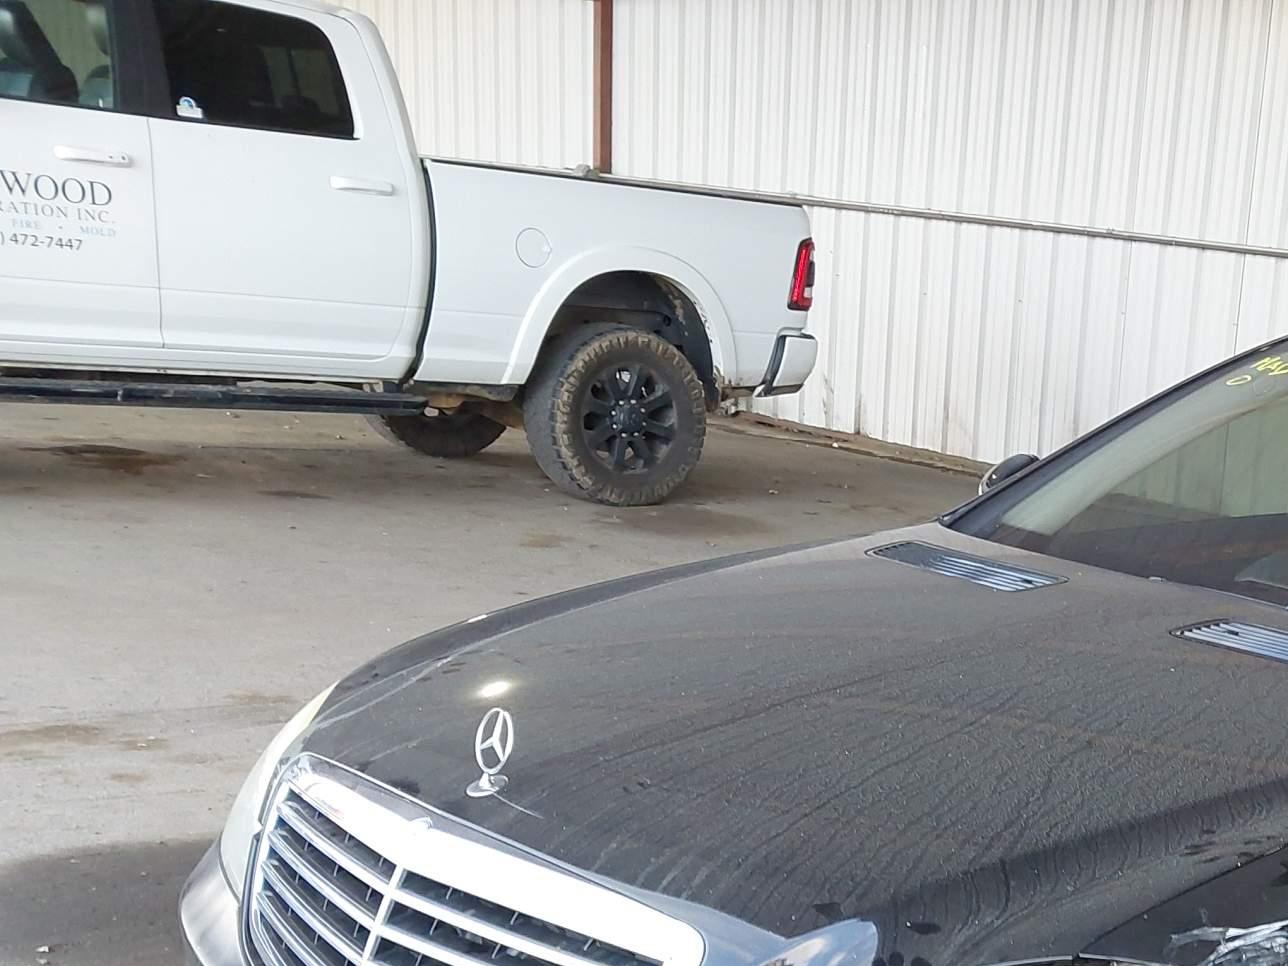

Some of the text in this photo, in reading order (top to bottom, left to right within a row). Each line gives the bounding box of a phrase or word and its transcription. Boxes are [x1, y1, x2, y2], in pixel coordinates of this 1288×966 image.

[77, 207, 116, 225] INC.
[12, 218, 117, 237] FIRE MOLD
[9, 232, 83, 251] 472-7447
